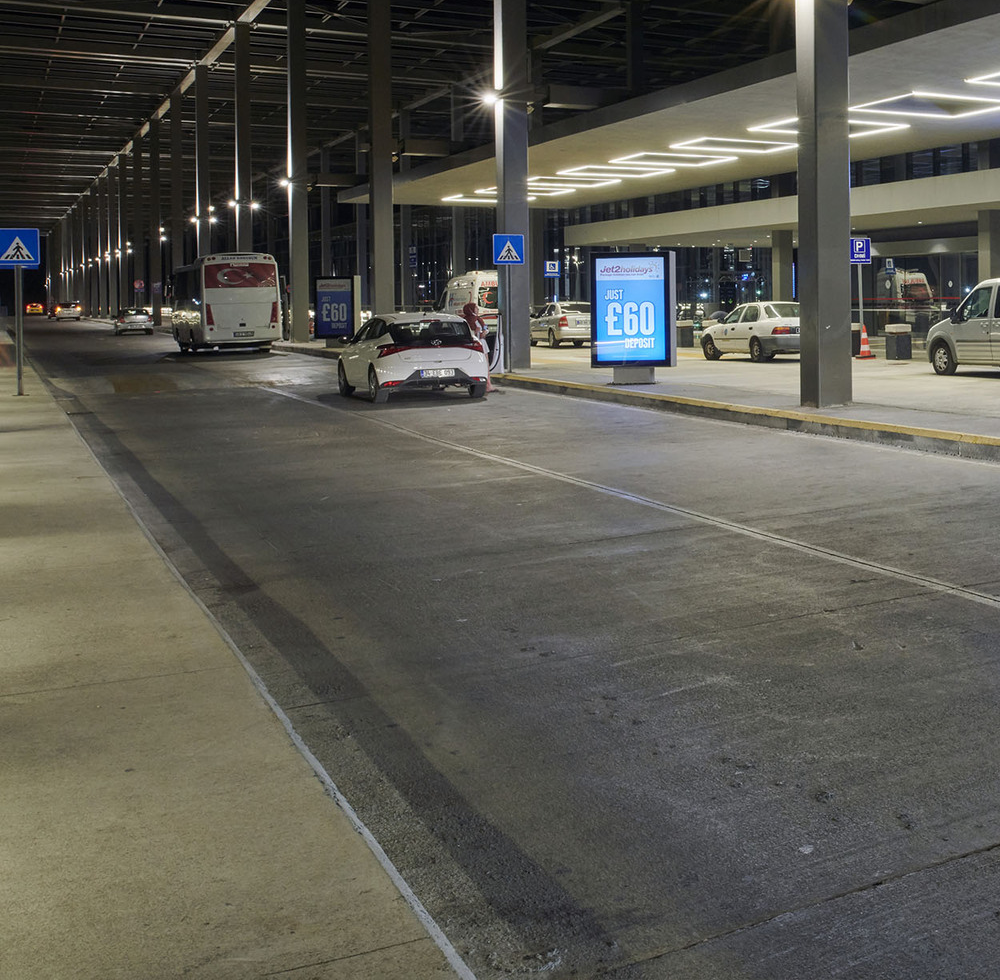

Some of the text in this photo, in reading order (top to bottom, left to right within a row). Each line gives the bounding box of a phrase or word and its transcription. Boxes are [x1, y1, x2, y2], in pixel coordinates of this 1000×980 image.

[604, 289, 624, 300] JUST
[321, 303, 347, 321] £60
[604, 301, 655, 336] £60
[624, 337, 656, 349] DEPOSIT
